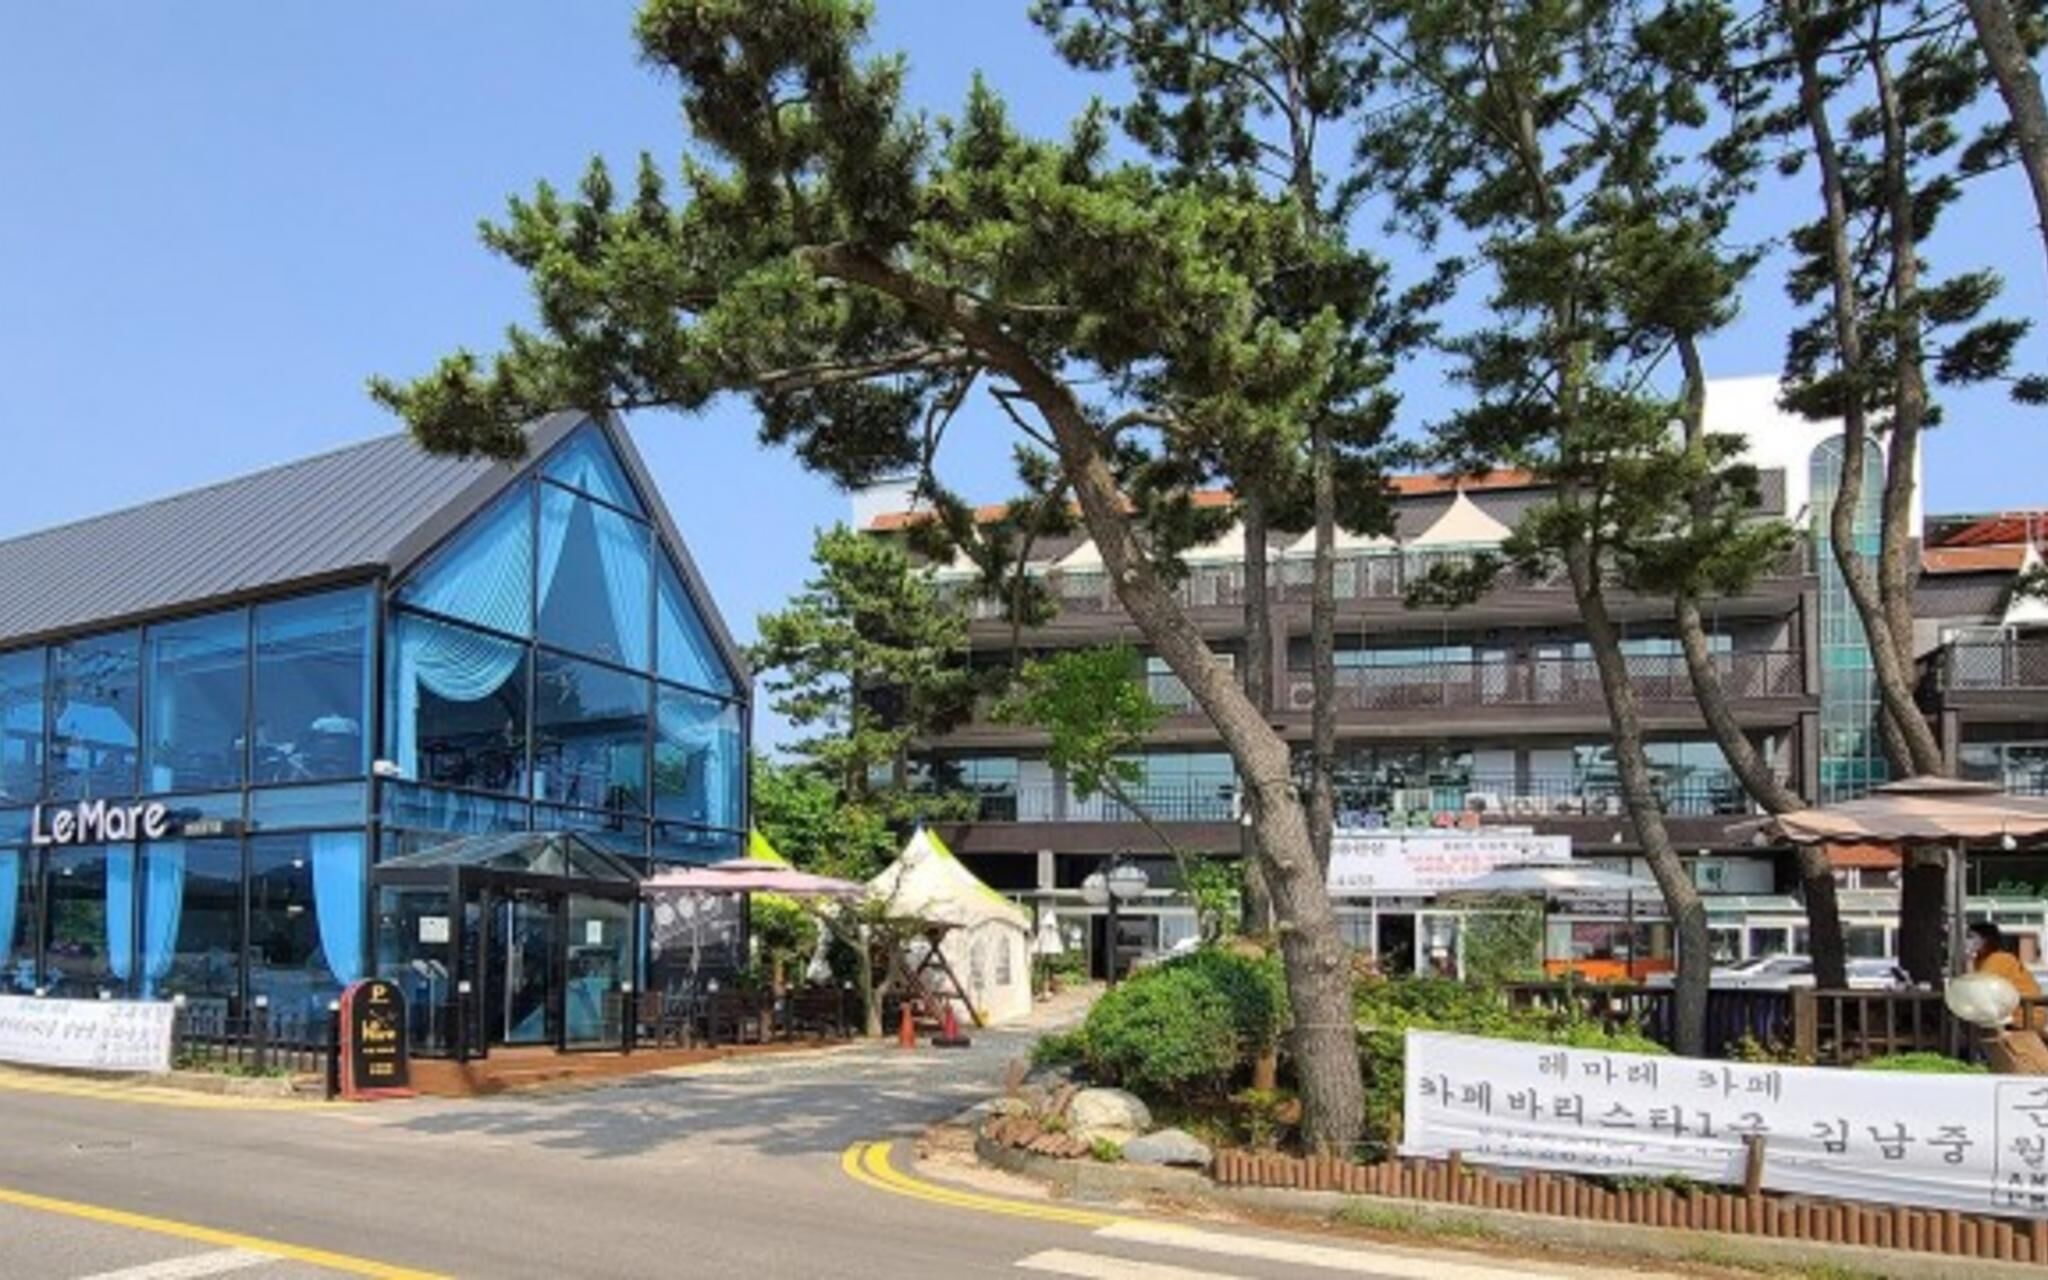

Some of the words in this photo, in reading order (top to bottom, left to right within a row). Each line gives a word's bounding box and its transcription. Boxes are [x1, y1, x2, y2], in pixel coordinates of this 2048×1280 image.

[1538, 1051, 1659, 1090] 레마레
[1698, 1066, 1782, 1102] 카페
[1811, 1117, 1974, 1164] 김남중
